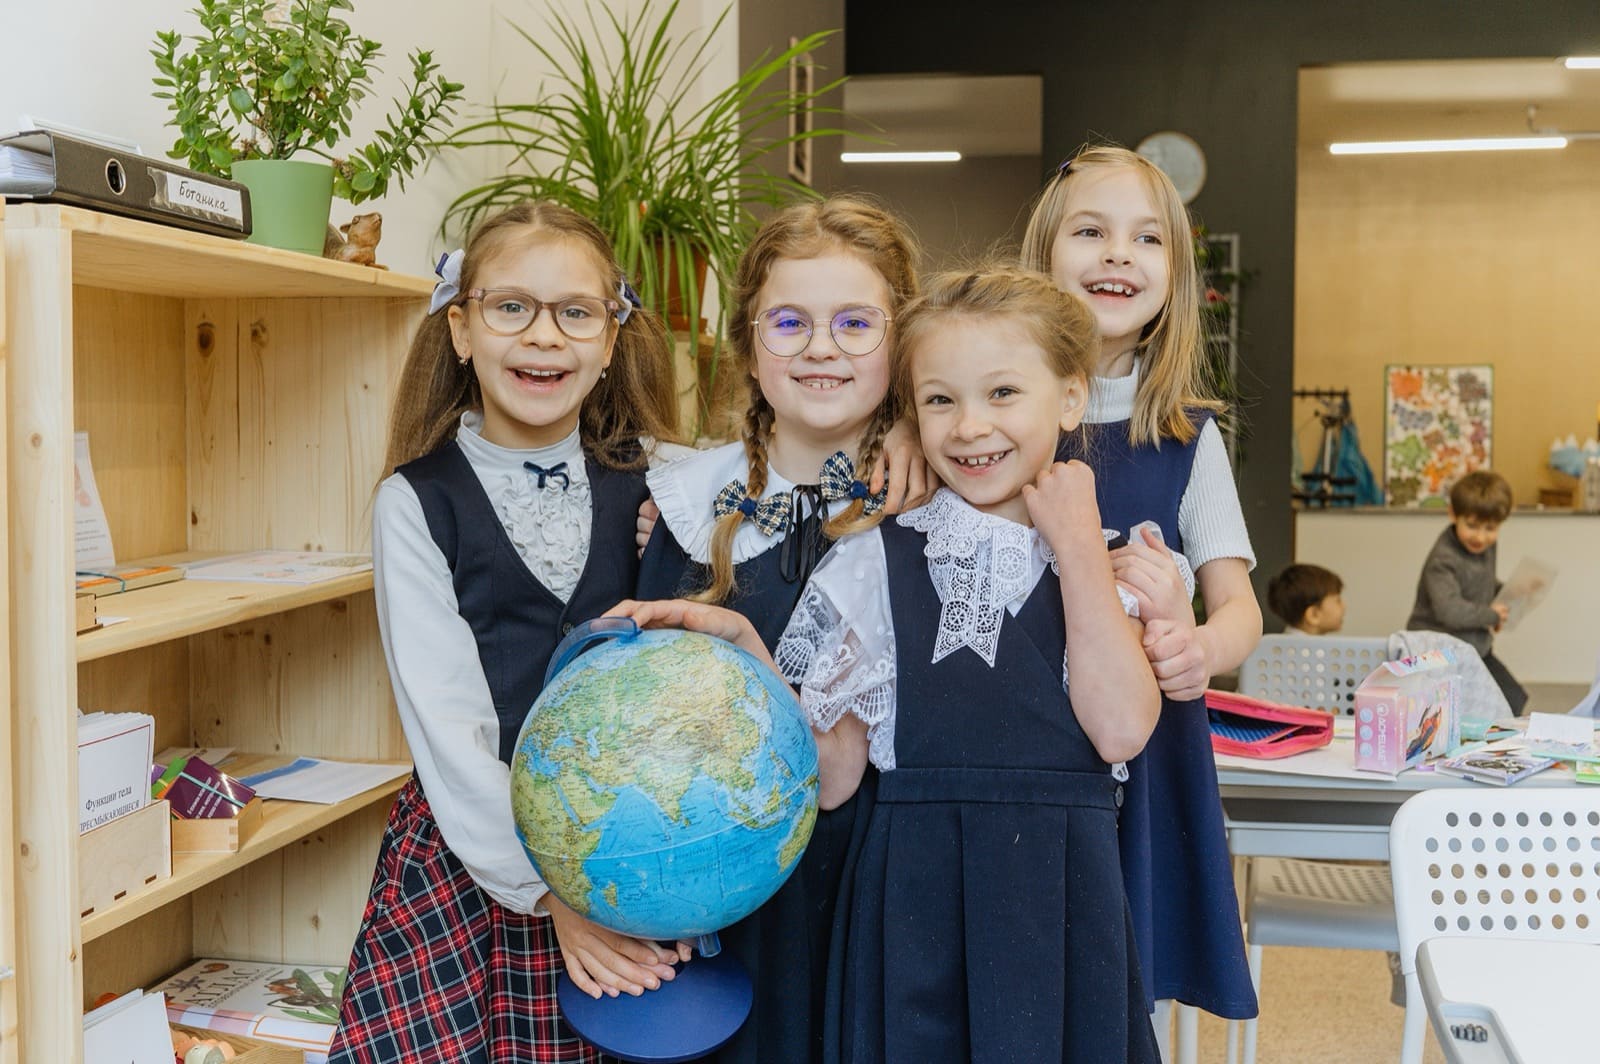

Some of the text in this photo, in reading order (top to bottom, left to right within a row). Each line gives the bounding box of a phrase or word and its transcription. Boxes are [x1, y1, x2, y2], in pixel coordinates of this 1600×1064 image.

[180, 181, 229, 212] Ботаника
[85, 786, 132, 812] Функции тела
